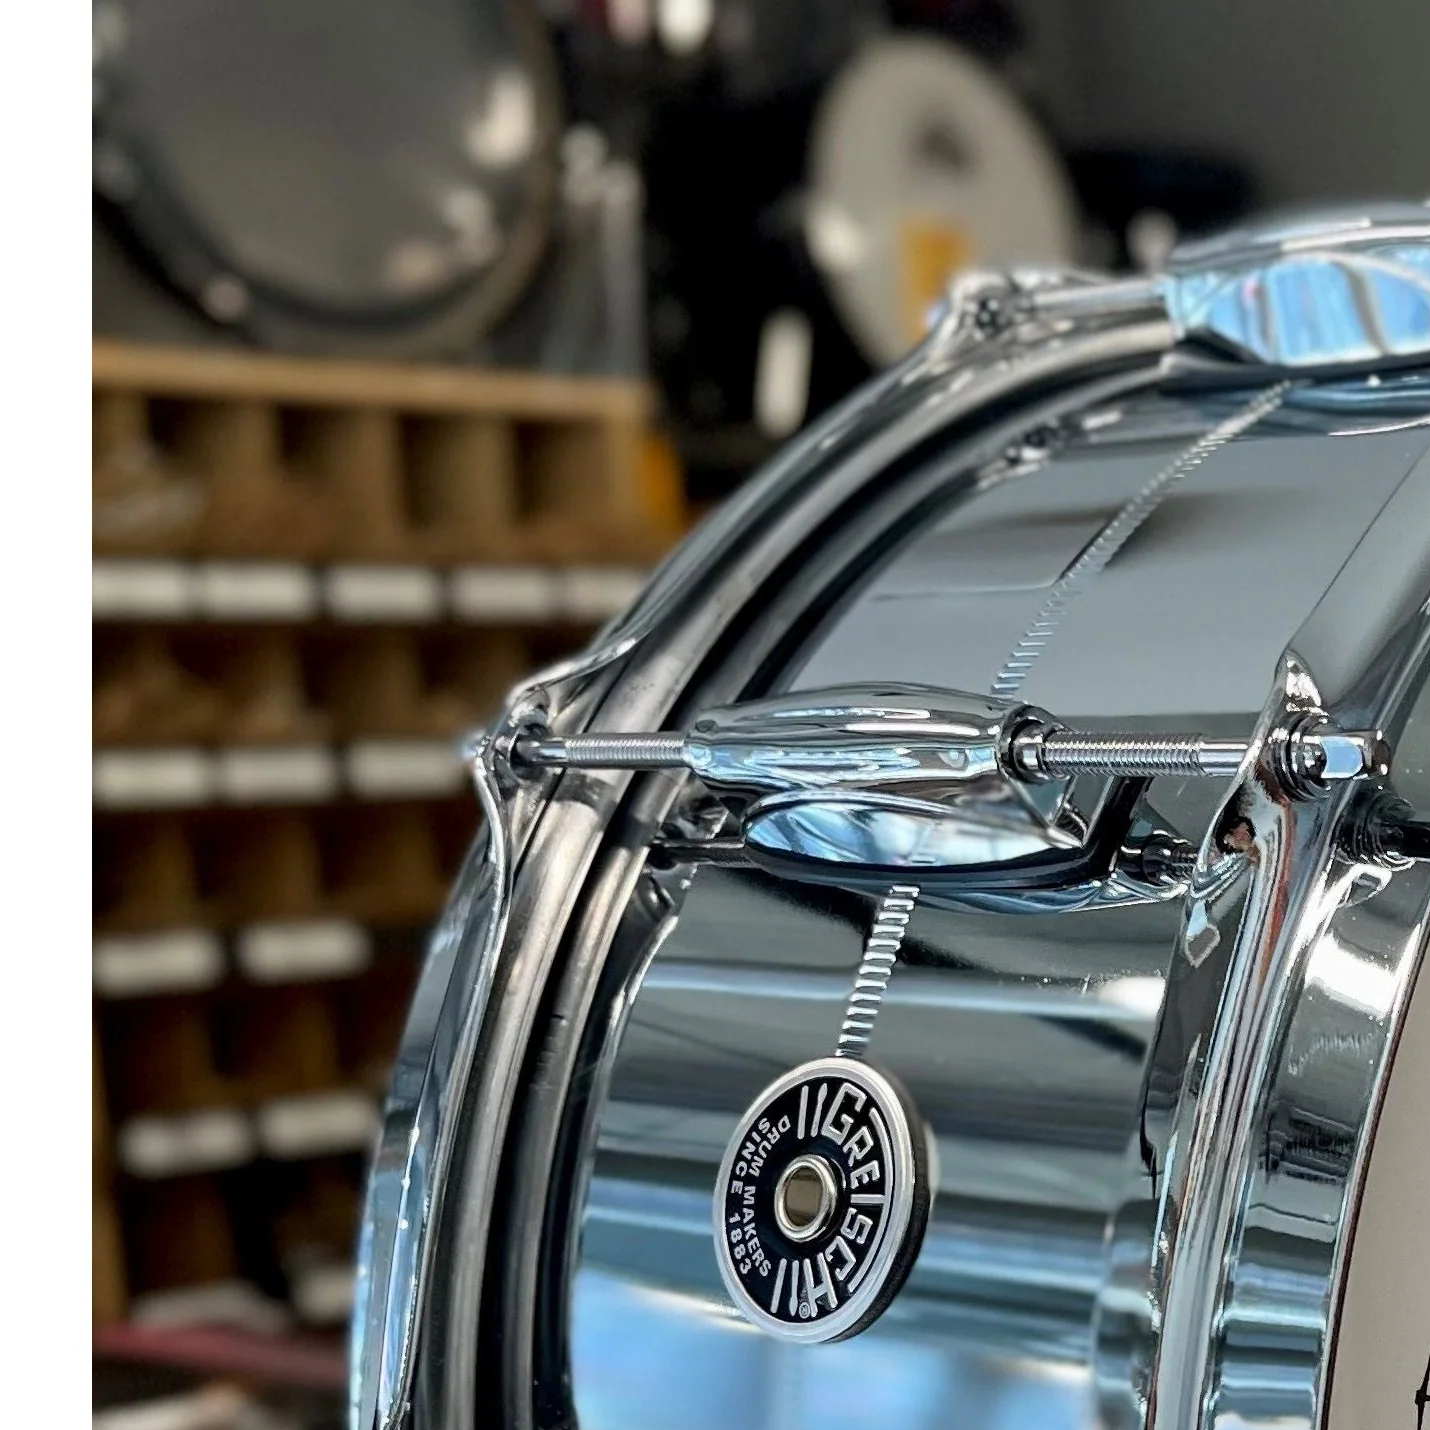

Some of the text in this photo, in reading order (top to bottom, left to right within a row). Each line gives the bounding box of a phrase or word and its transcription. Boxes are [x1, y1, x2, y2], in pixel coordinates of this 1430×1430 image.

[728, 1116, 772, 1276] SINCE 1883
[740, 1114, 792, 1277] DRUM MAKERS
[803, 1081, 892, 1318] GRETSCH
